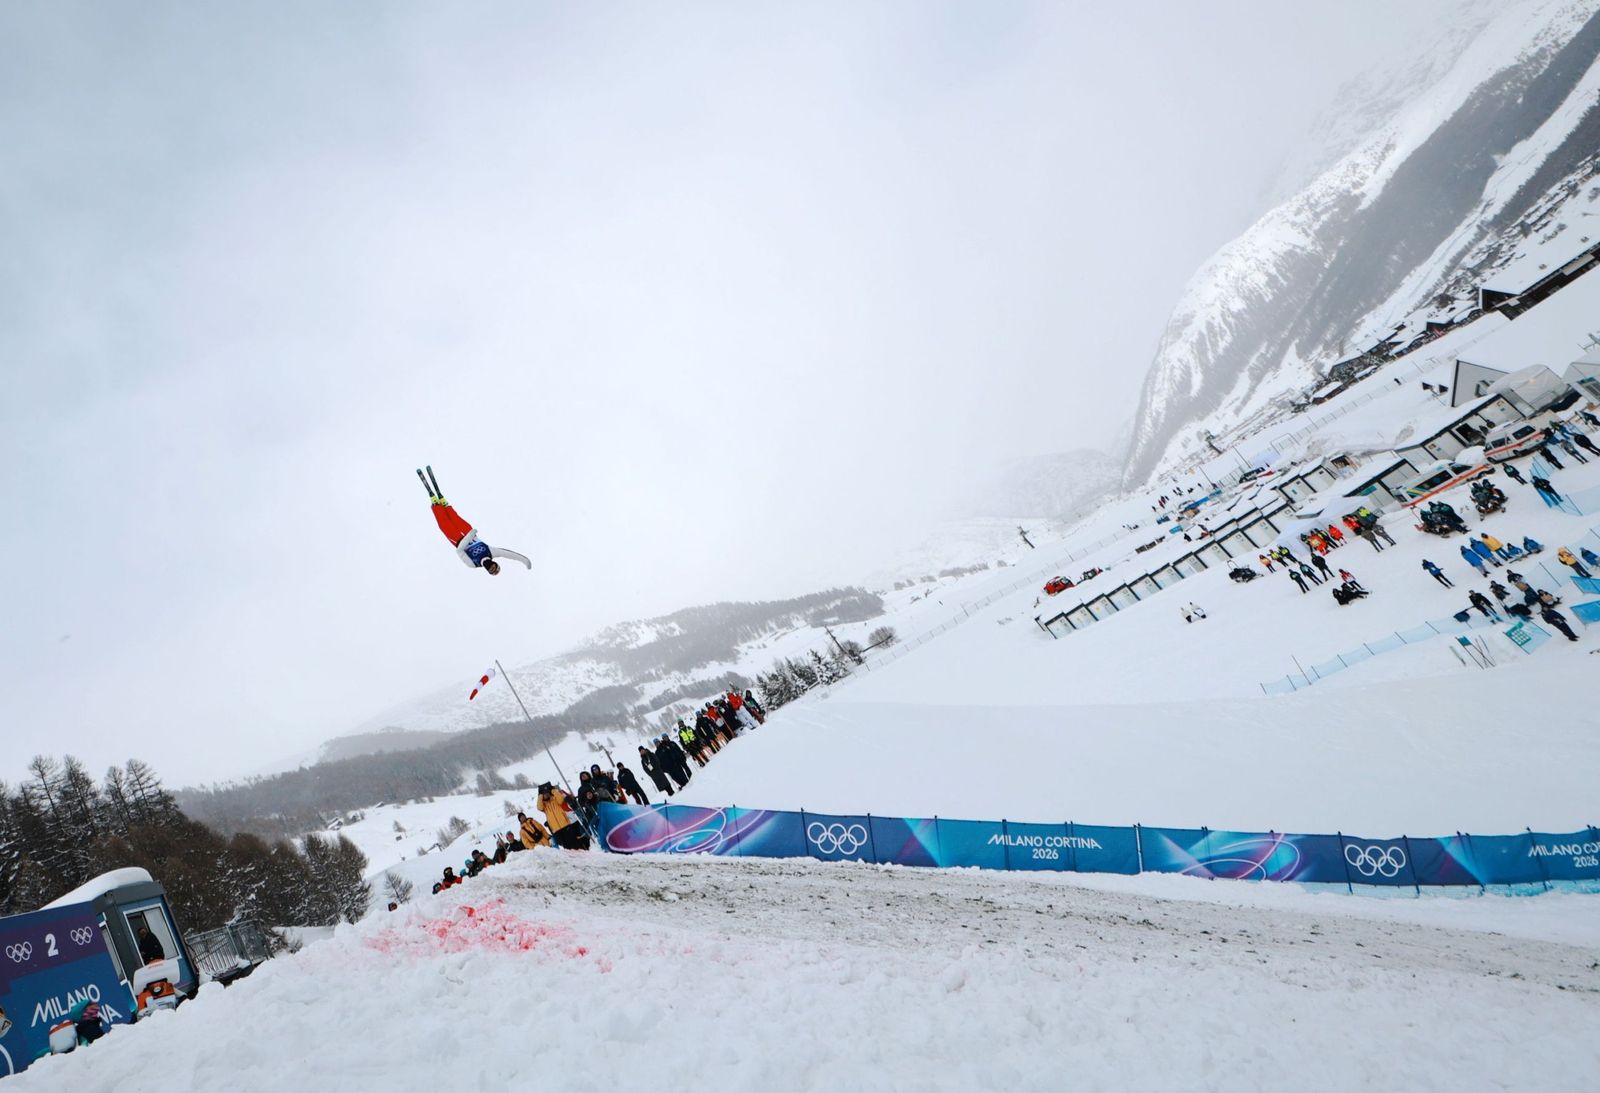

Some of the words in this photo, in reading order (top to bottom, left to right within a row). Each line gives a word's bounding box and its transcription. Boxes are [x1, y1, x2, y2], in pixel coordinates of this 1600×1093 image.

[988, 834, 1043, 847] MILANO
[1045, 836, 1103, 849] CORTINA
[1032, 848, 1059, 859] 2026
[1528, 844, 1582, 857] MILANO
[1573, 855, 1599, 867] 2026
[45, 933, 59, 957] 2
[31, 984, 100, 1028] MILANO
